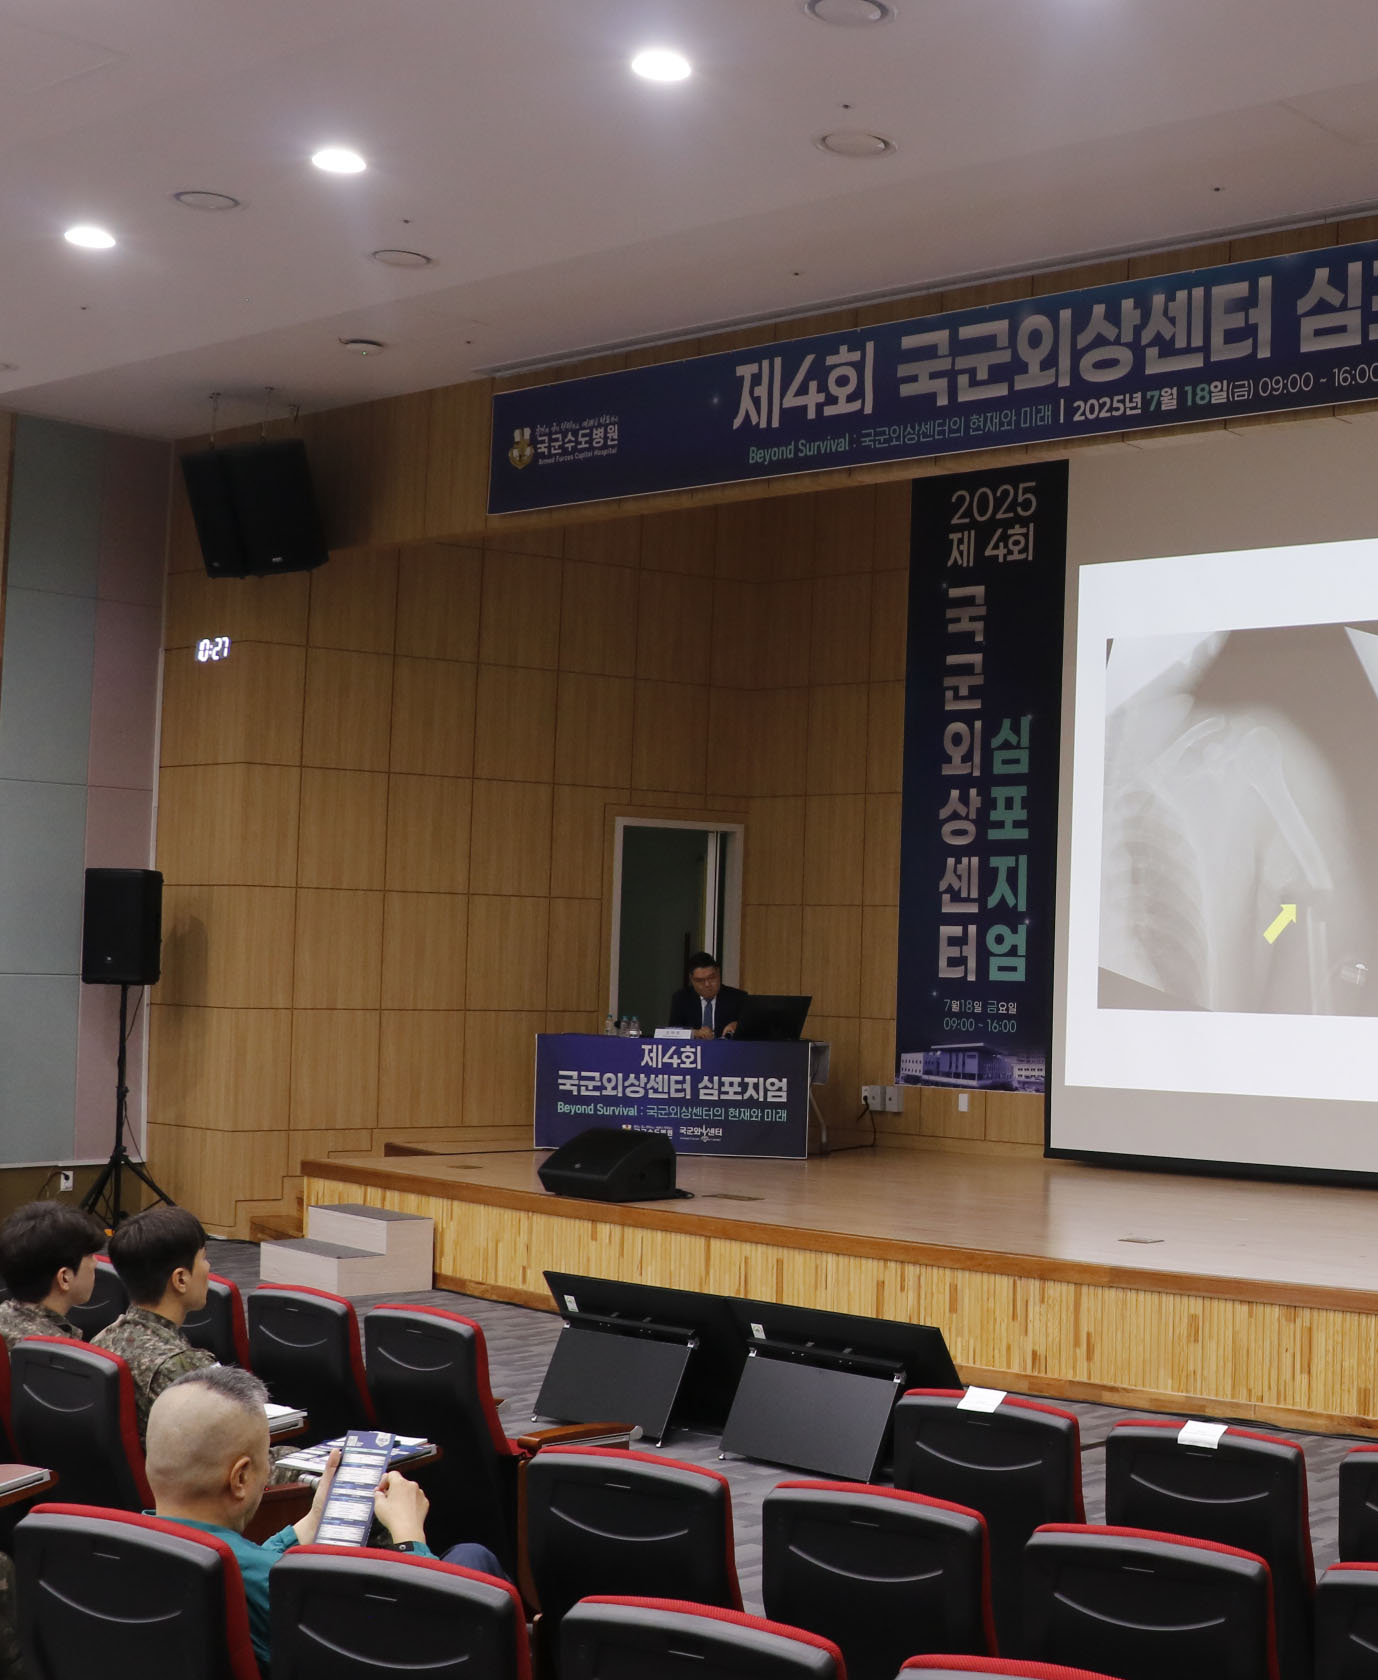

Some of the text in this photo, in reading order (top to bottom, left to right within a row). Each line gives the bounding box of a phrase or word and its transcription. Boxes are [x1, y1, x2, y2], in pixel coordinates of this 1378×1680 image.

[733, 341, 874, 430] 제4회
[898, 276, 1273, 407] 국군외상센터
[749, 440, 795, 464] Beyond
[798, 434, 849, 457] Survival
[860, 418, 965, 448] 국군외상센터의
[969, 410, 1017, 436] 현재와
[1020, 403, 1052, 427] 미래
[1072, 391, 1142, 422] 2025년
[1146, 388, 1178, 411] 7월
[1259, 372, 1314, 397] 09:00
[537, 424, 618, 455] 국군수도병원
[951, 482, 1037, 524] 2025
[938, 585, 987, 981] 국군외상센터
[986, 717, 1032, 981] 심포지엄
[987, 1000, 1017, 1014] 금요일
[944, 1018, 975, 1031] 09:00
[987, 1019, 1017, 1032] 16:00
[641, 1044, 702, 1070] 제4회
[557, 1070, 788, 1103] 국군외상센터 심포지엄
[557, 1101, 594, 1116] Beyond
[597, 1103, 637, 1117] Survival
[646, 1106, 725, 1121] 국군외상센터의
[728, 1107, 762, 1122] 현재와
[764, 1108, 788, 1123] 미래
